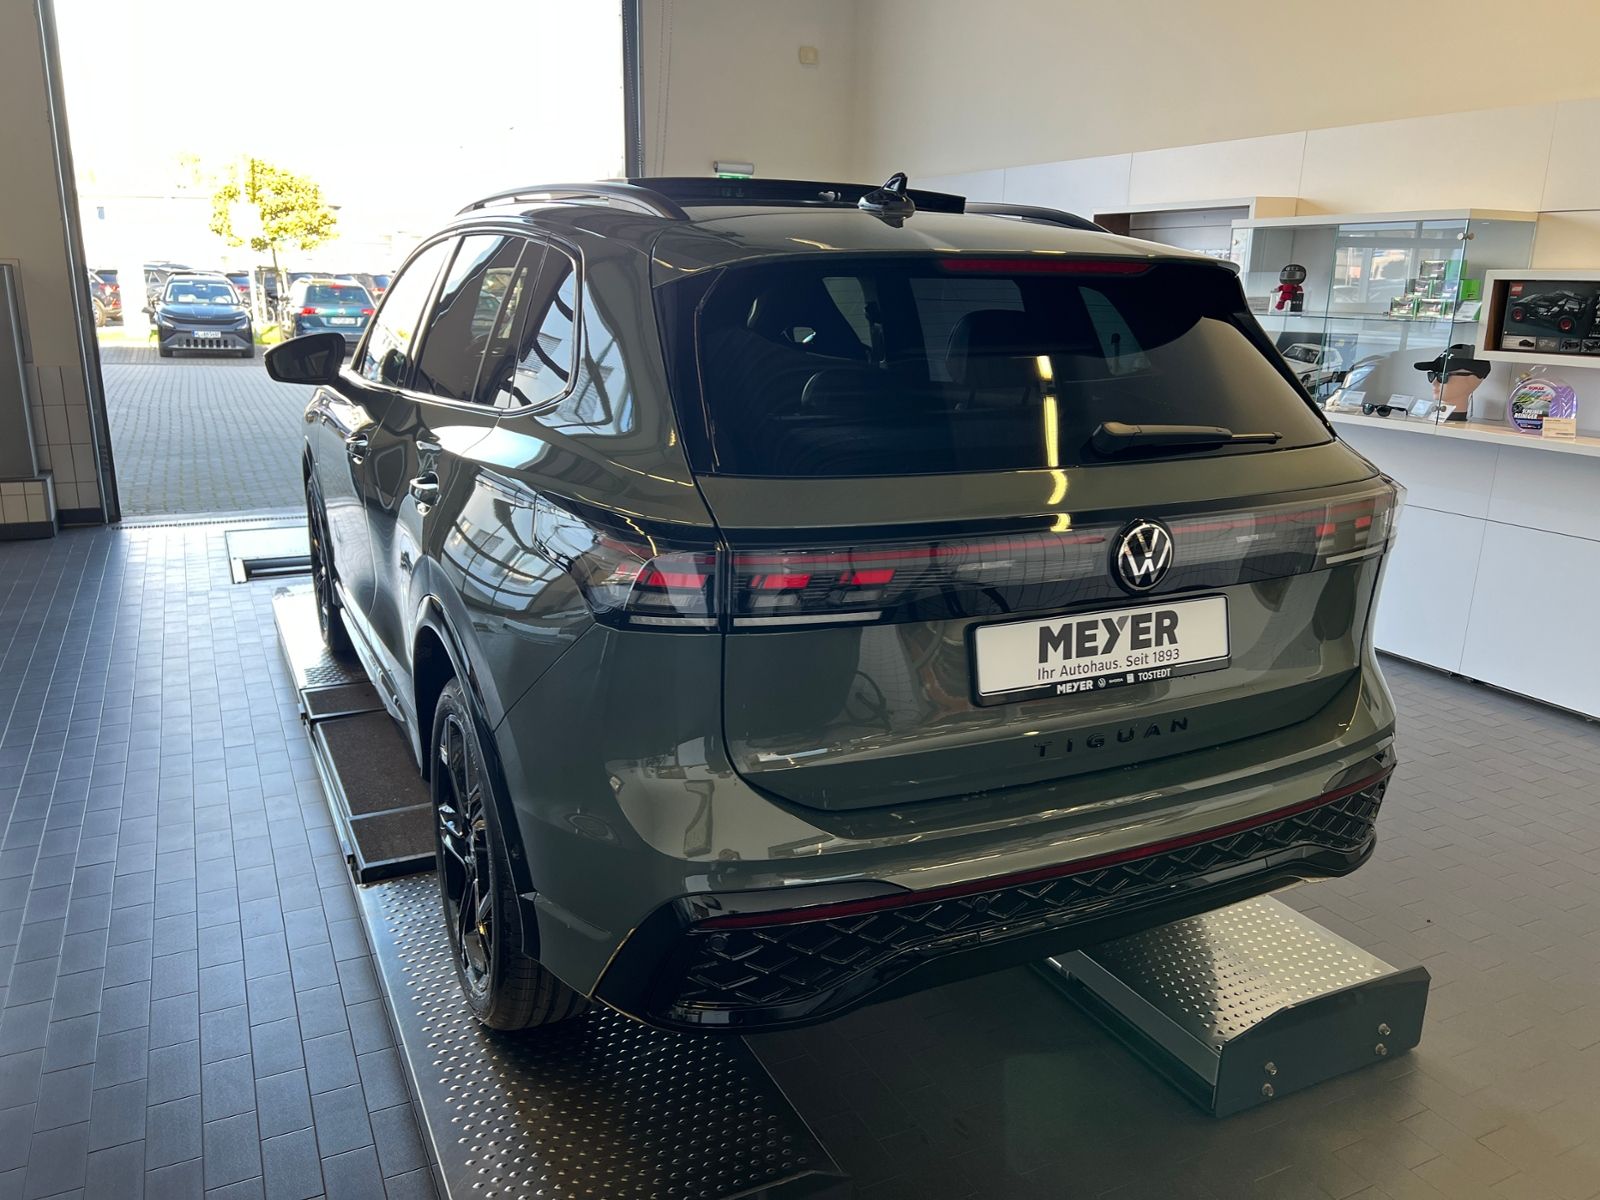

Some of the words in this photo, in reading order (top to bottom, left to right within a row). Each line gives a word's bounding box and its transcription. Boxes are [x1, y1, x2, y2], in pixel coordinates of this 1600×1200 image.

[1038, 609, 1179, 663] MEYER
[1037, 666, 1056, 681] Ihr
[1059, 658, 1122, 678] Autohaus.
[1126, 652, 1149, 667] Seit
[1153, 648, 1180, 662] 1893
[1056, 679, 1094, 695] MEYER
[1137, 667, 1172, 682] TOSTEDT
[1033, 716, 1189, 758] TIGUAN
